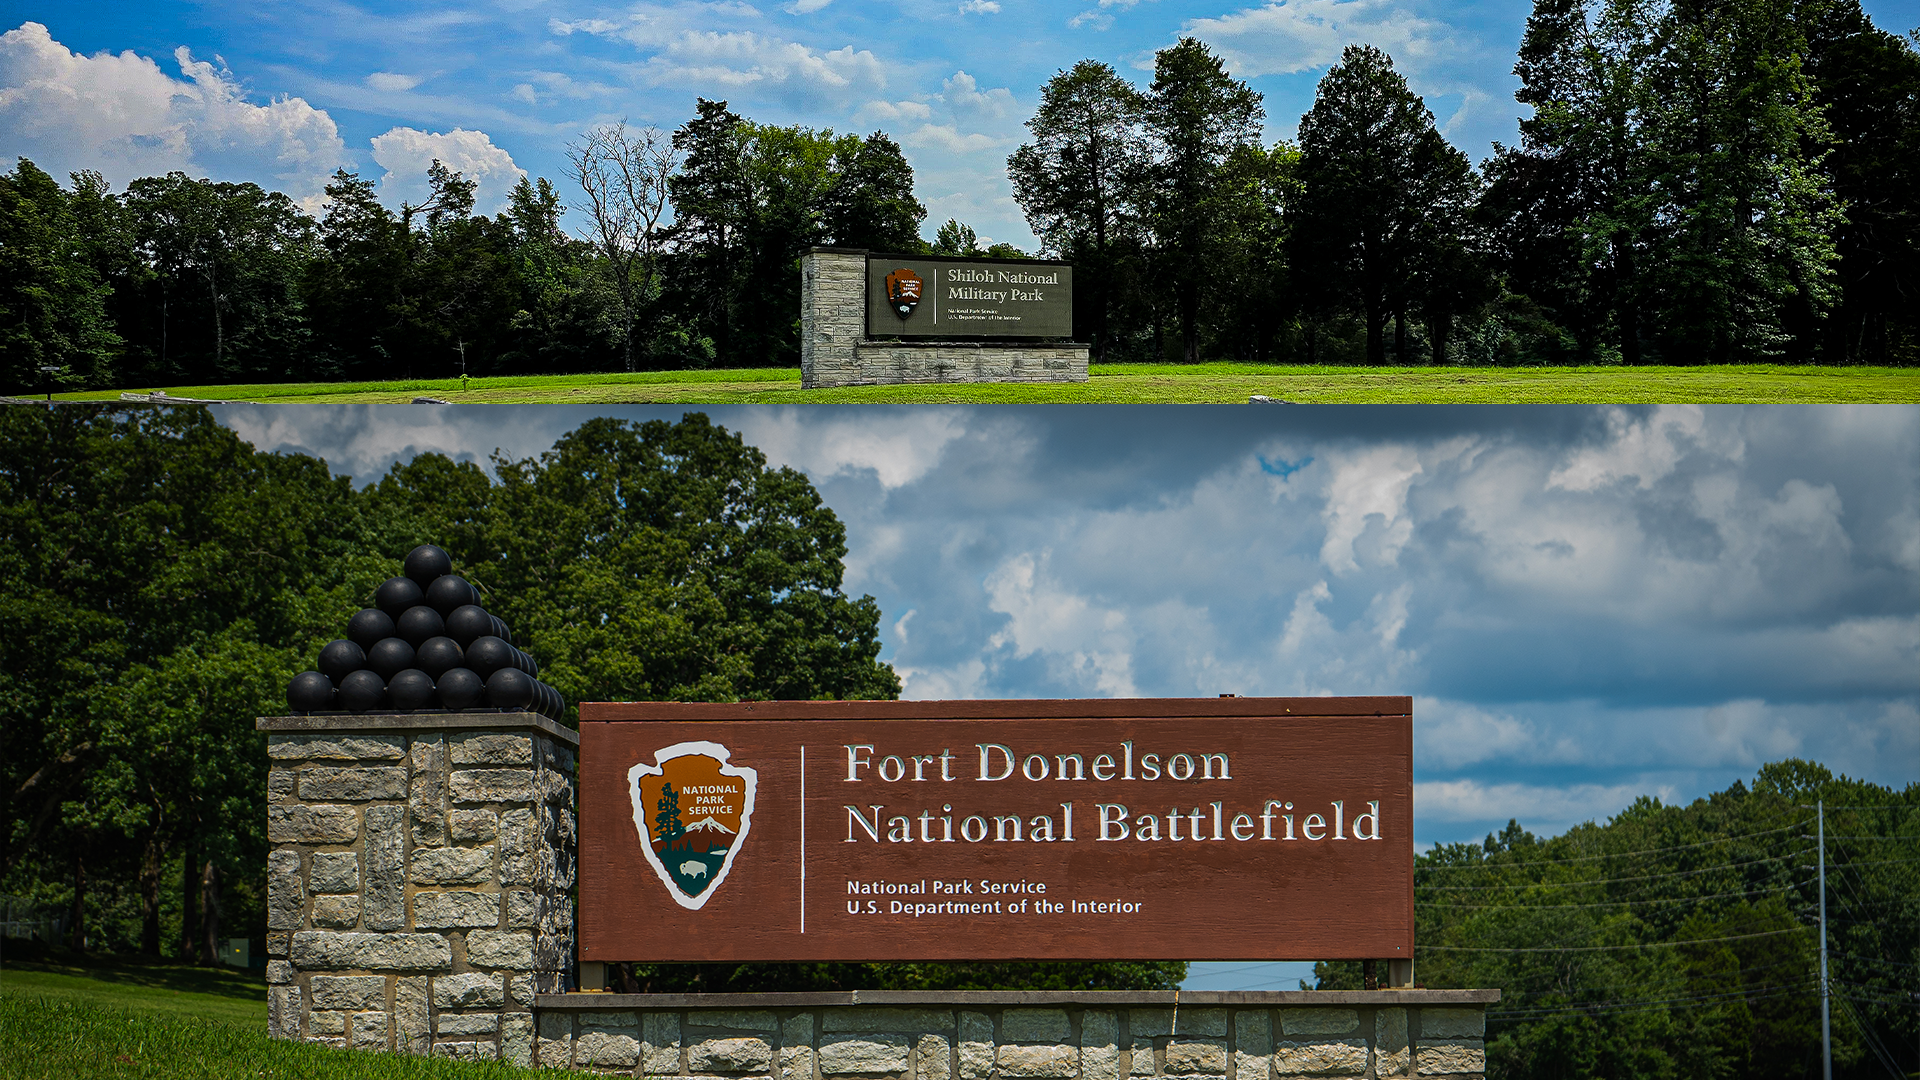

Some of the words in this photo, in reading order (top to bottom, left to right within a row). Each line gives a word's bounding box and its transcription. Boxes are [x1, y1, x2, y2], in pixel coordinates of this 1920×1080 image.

[948, 269, 994, 283] Shiloh
[998, 271, 1058, 285] National
[949, 287, 1007, 303] Military
[1011, 289, 1044, 301] Park
[843, 743, 956, 782] Fort
[976, 740, 1233, 782] Donelson
[682, 785, 738, 794] NATIONAL
[696, 796, 725, 805] PARK
[688, 805, 733, 815] SERVICE
[843, 802, 1076, 843] National
[1096, 800, 1382, 842] Battlefield
[846, 880, 926, 894] National
[933, 880, 973, 894] Park
[980, 880, 1047, 894] Service
[846, 900, 883, 914] U.S.
[890, 900, 1001, 917] Department
[1008, 899, 1028, 914] of
[1034, 900, 1064, 914] the
[1071, 900, 1142, 914] Interior
